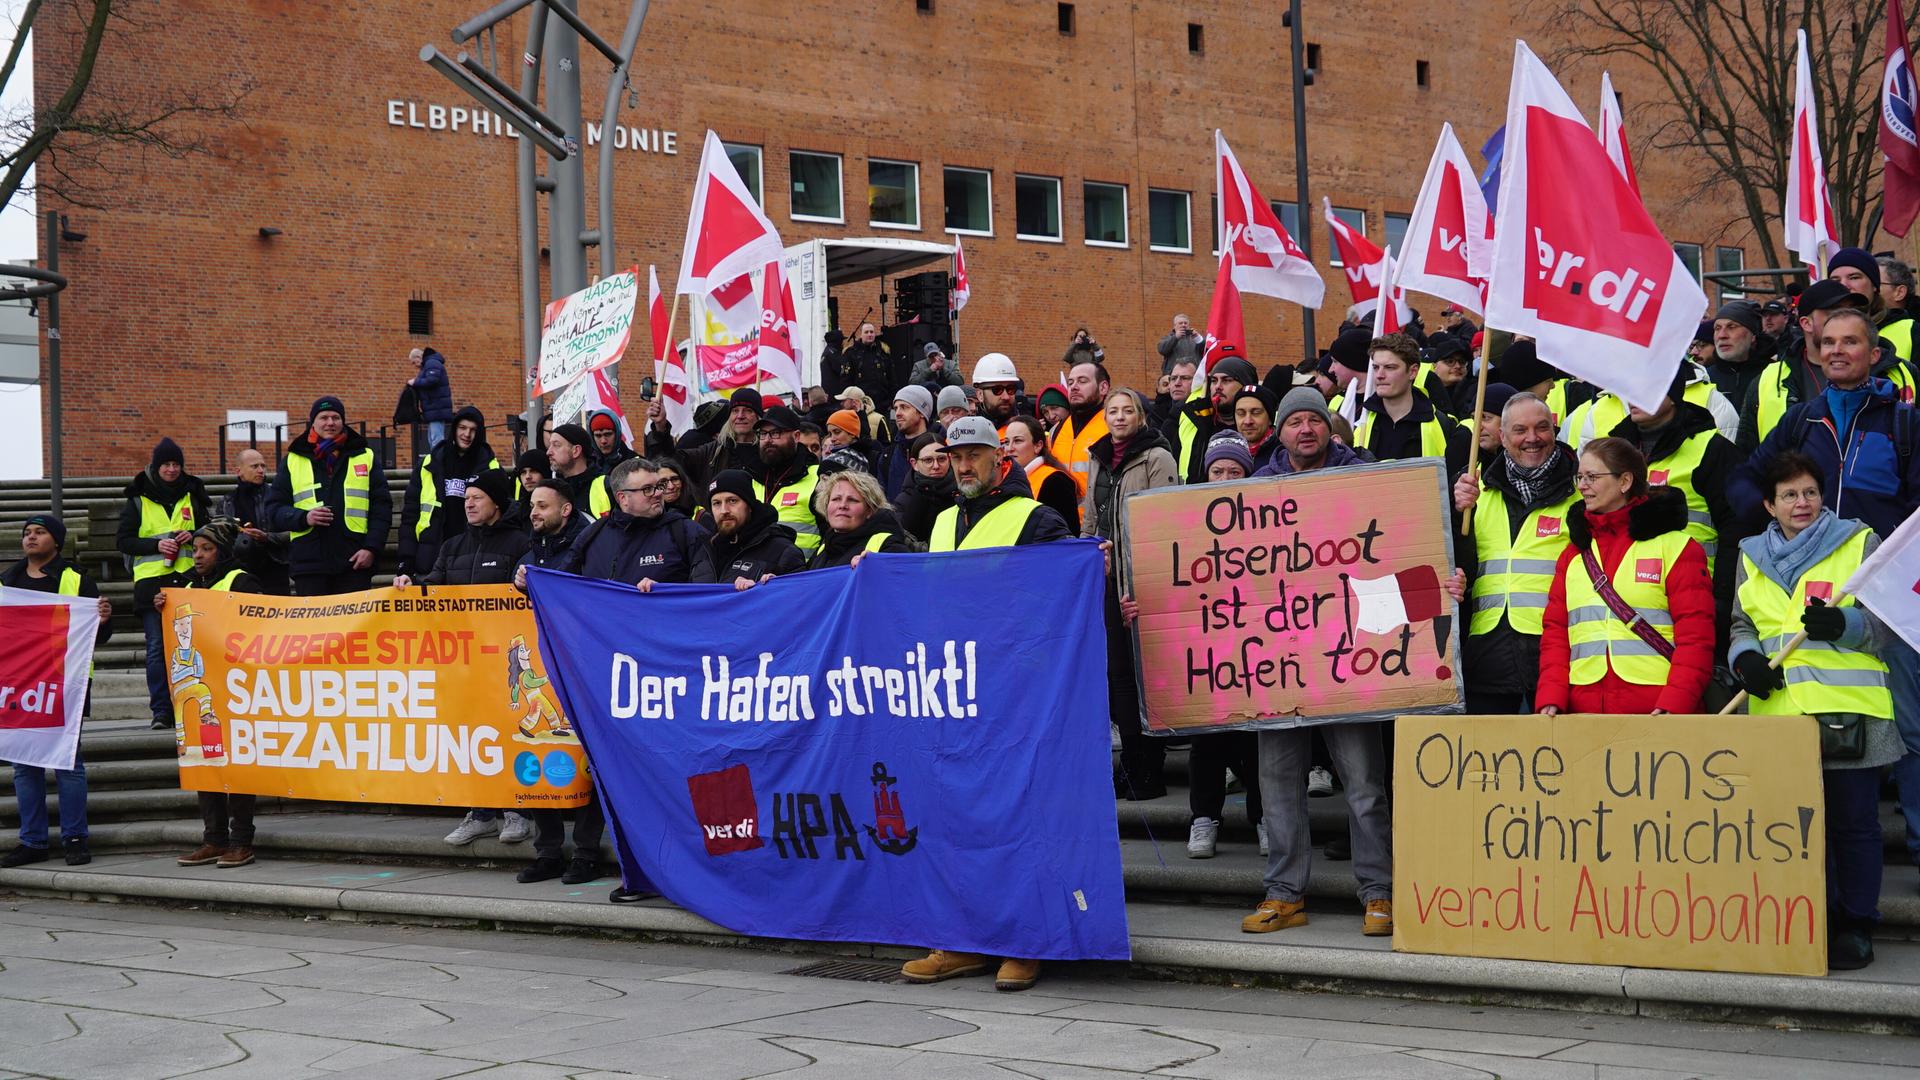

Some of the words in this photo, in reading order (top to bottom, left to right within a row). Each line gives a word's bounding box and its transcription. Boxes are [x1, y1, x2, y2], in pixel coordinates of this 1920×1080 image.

[583, 272, 636, 302] HADAG
[569, 313, 602, 339] ALLE
[1205, 492, 1298, 535] Ohne
[1538, 527, 1559, 535] ver.di
[640, 555, 656, 564] HPA
[1172, 518, 1384, 586] Lotsenboot
[1637, 571, 1660, 581] ver.di
[239, 600, 391, 619] VER.DI-VERTRAUENSLEUTE
[395, 599, 413, 612] BEI
[416, 599, 436, 612] DER
[1199, 585, 1247, 633] ist
[1264, 579, 1335, 633] der
[224, 632, 369, 664] SAUBERE
[375, 631, 474, 664] STADT
[1187, 636, 1306, 698] Hafen
[227, 668, 436, 719] SAUBERE
[610, 652, 687, 719] Der
[701, 652, 815, 722] Hafen
[826, 640, 978, 719] streikt!
[229, 719, 504, 777] BEZAHLUNG
[1416, 732, 1564, 796] Ohne
[1605, 747, 1738, 801] uns
[565, 792, 578, 801] und
[772, 792, 865, 860] HPA
[1482, 800, 1613, 863] fährt
[1633, 806, 1815, 864] nichts!
[1413, 866, 1550, 932] ver.di
[1569, 864, 1815, 945] Autobahn
